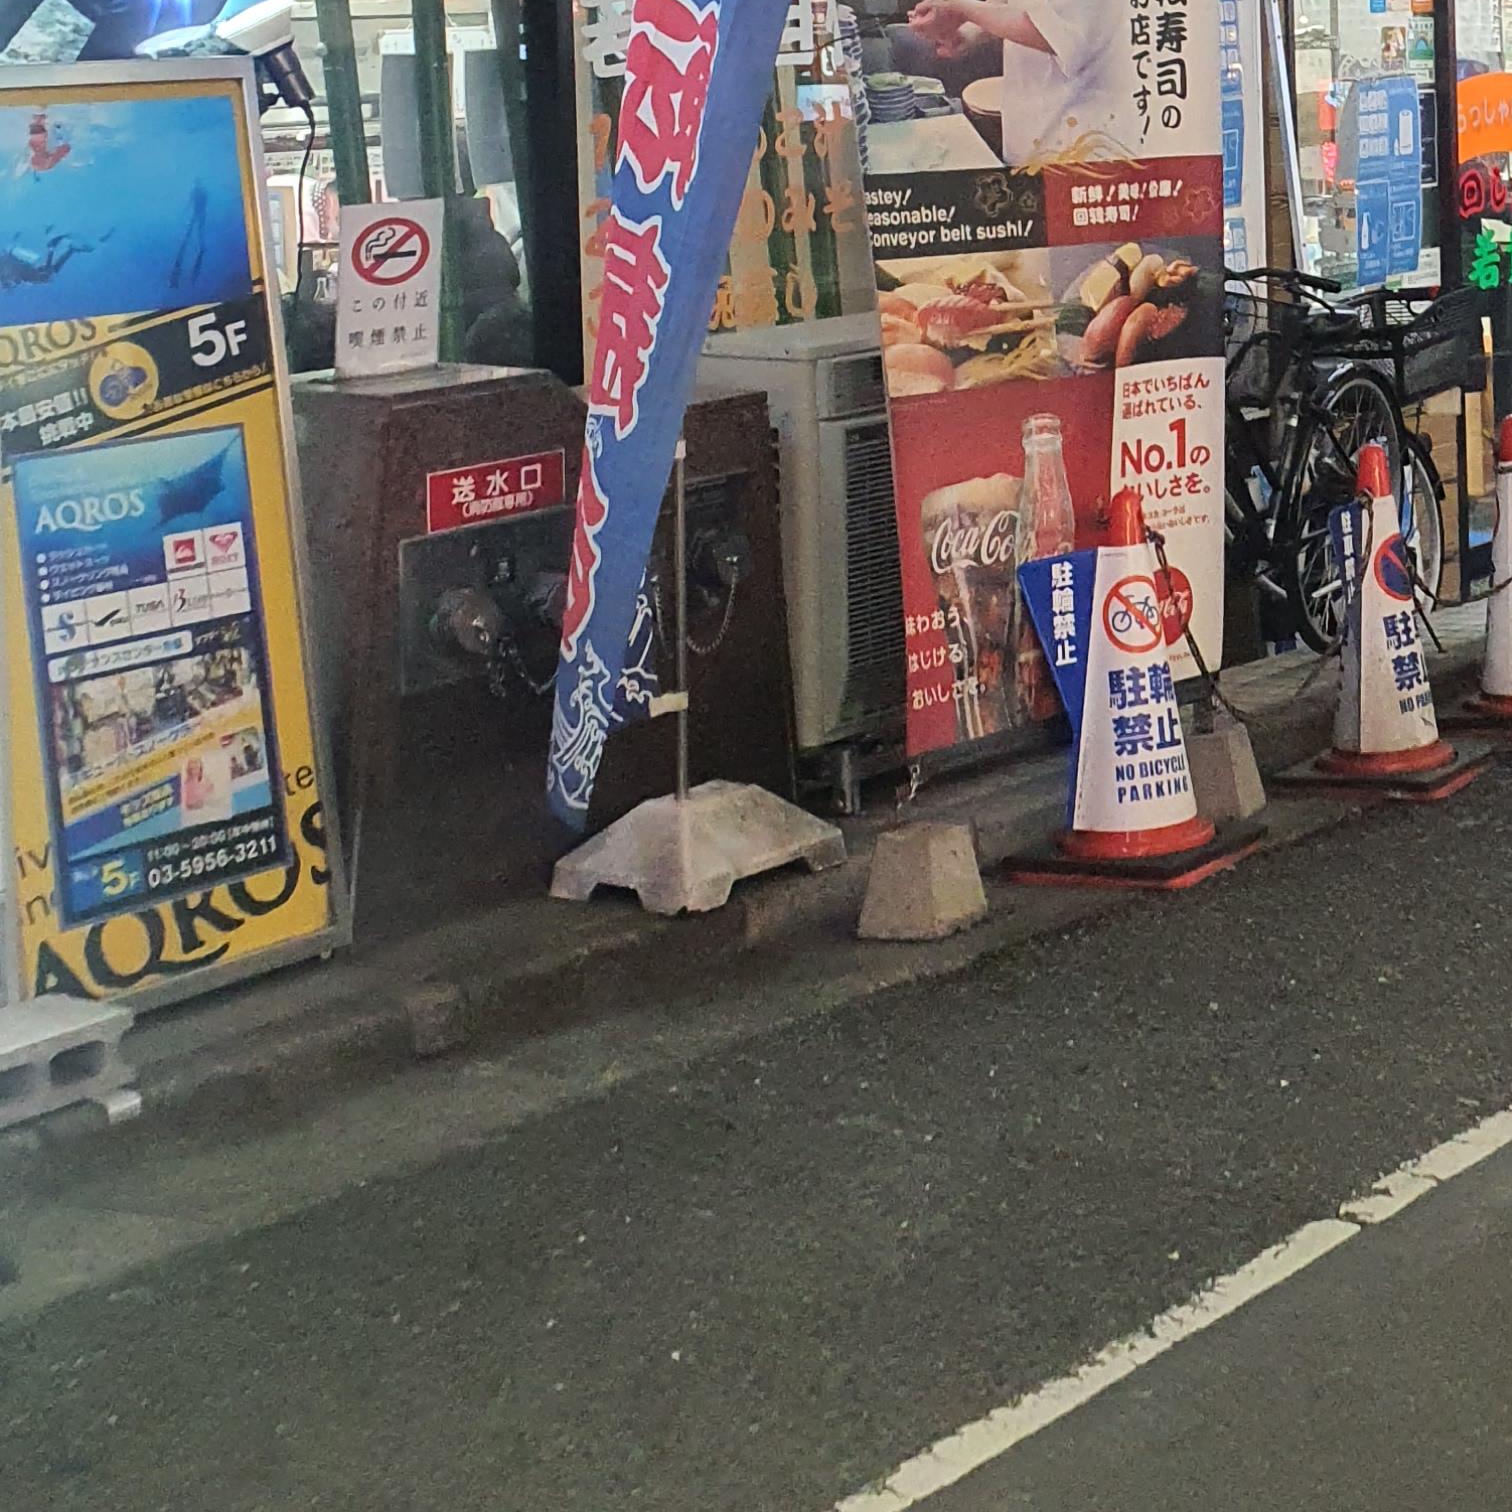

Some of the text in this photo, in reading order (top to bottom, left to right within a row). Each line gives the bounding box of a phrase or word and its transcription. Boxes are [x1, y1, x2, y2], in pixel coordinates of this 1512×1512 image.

[940, 223, 973, 243] belt
[976, 219, 1034, 240] sushi!
[352, 289, 430, 313] この付近
[188, 312, 248, 367] 5F
[348, 325, 428, 349] 喫煙禁止
[1121, 374, 1211, 399] 日本でいちばん
[1119, 417, 1211, 479] No.1の
[451, 462, 542, 505] 送水口
[1122, 473, 1211, 503] いしさを。
[34, 488, 146, 535] AQROS
[1050, 560, 1078, 667] 駐輪禁止
[907, 642, 964, 673] はじける
[1107, 662, 1176, 710] 駐輪
[1112, 706, 1182, 757] 禁止
[1115, 763, 1136, 782] NO
[1117, 775, 1189, 805] PARKING
[147, 835, 278, 889] 03-5956-3211
